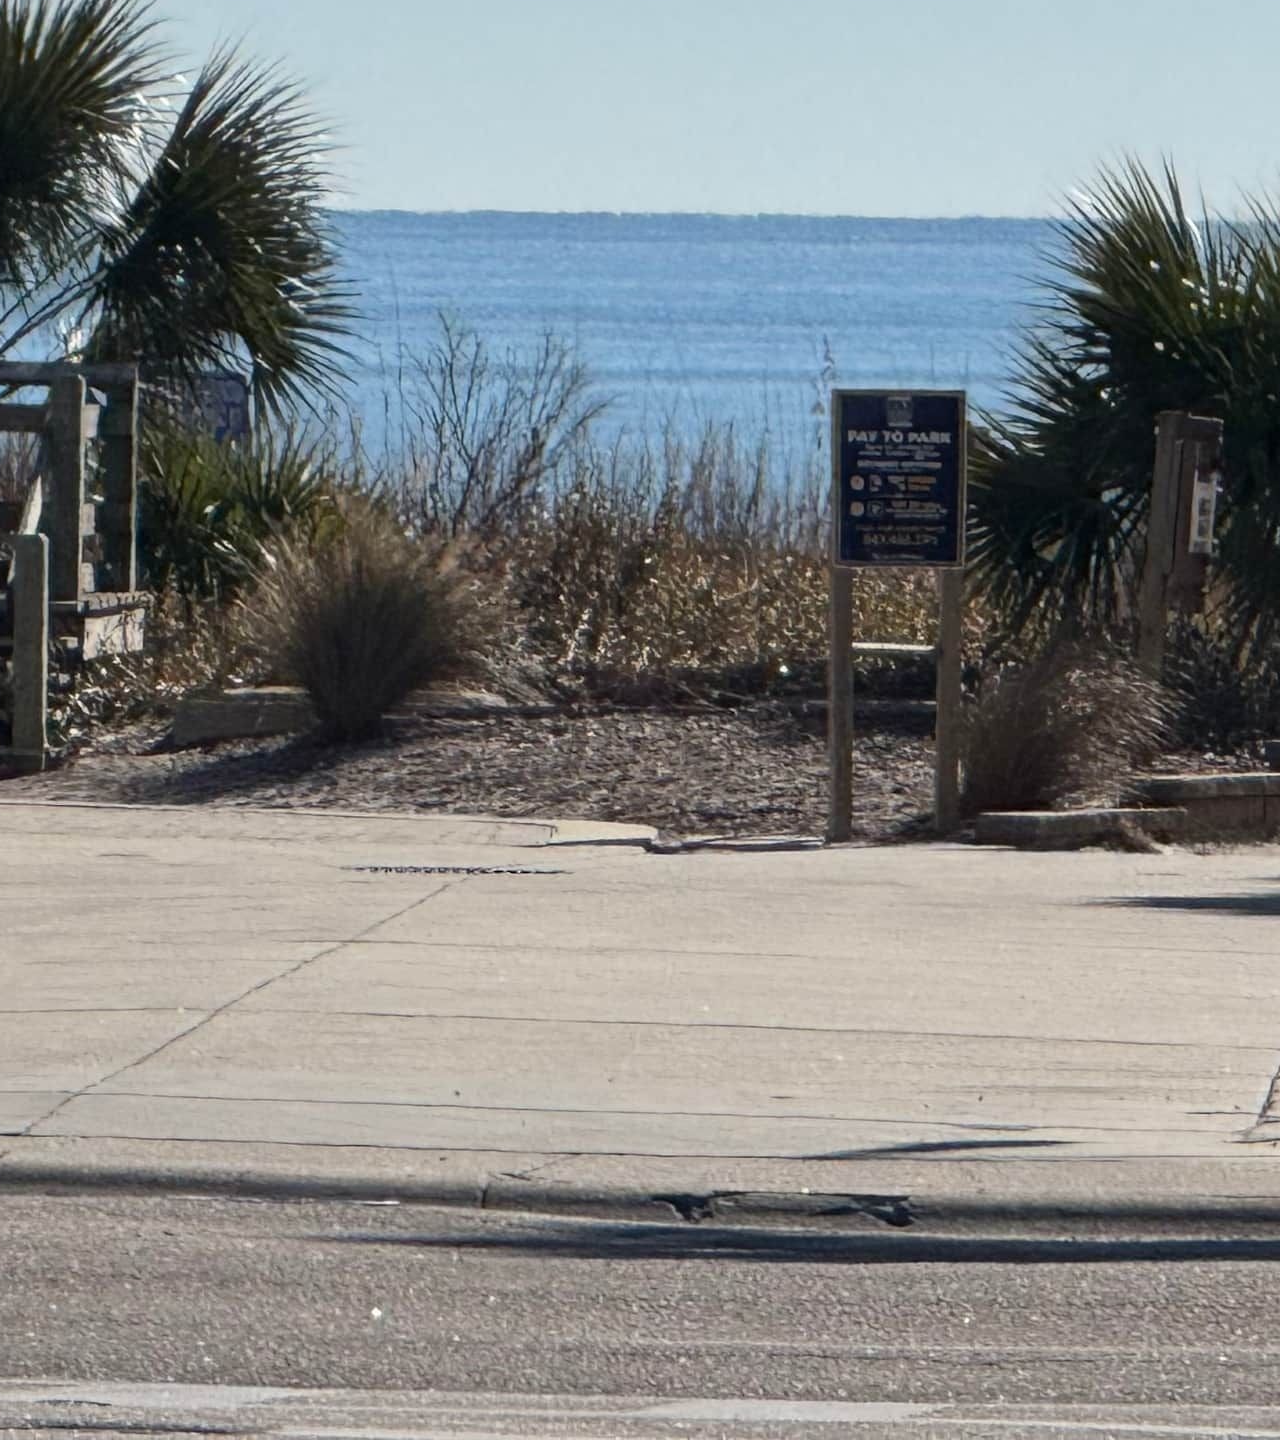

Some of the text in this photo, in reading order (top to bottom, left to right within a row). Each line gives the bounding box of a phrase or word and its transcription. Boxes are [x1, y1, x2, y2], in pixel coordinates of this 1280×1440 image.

[847, 429, 951, 444] PAY TO PARK
